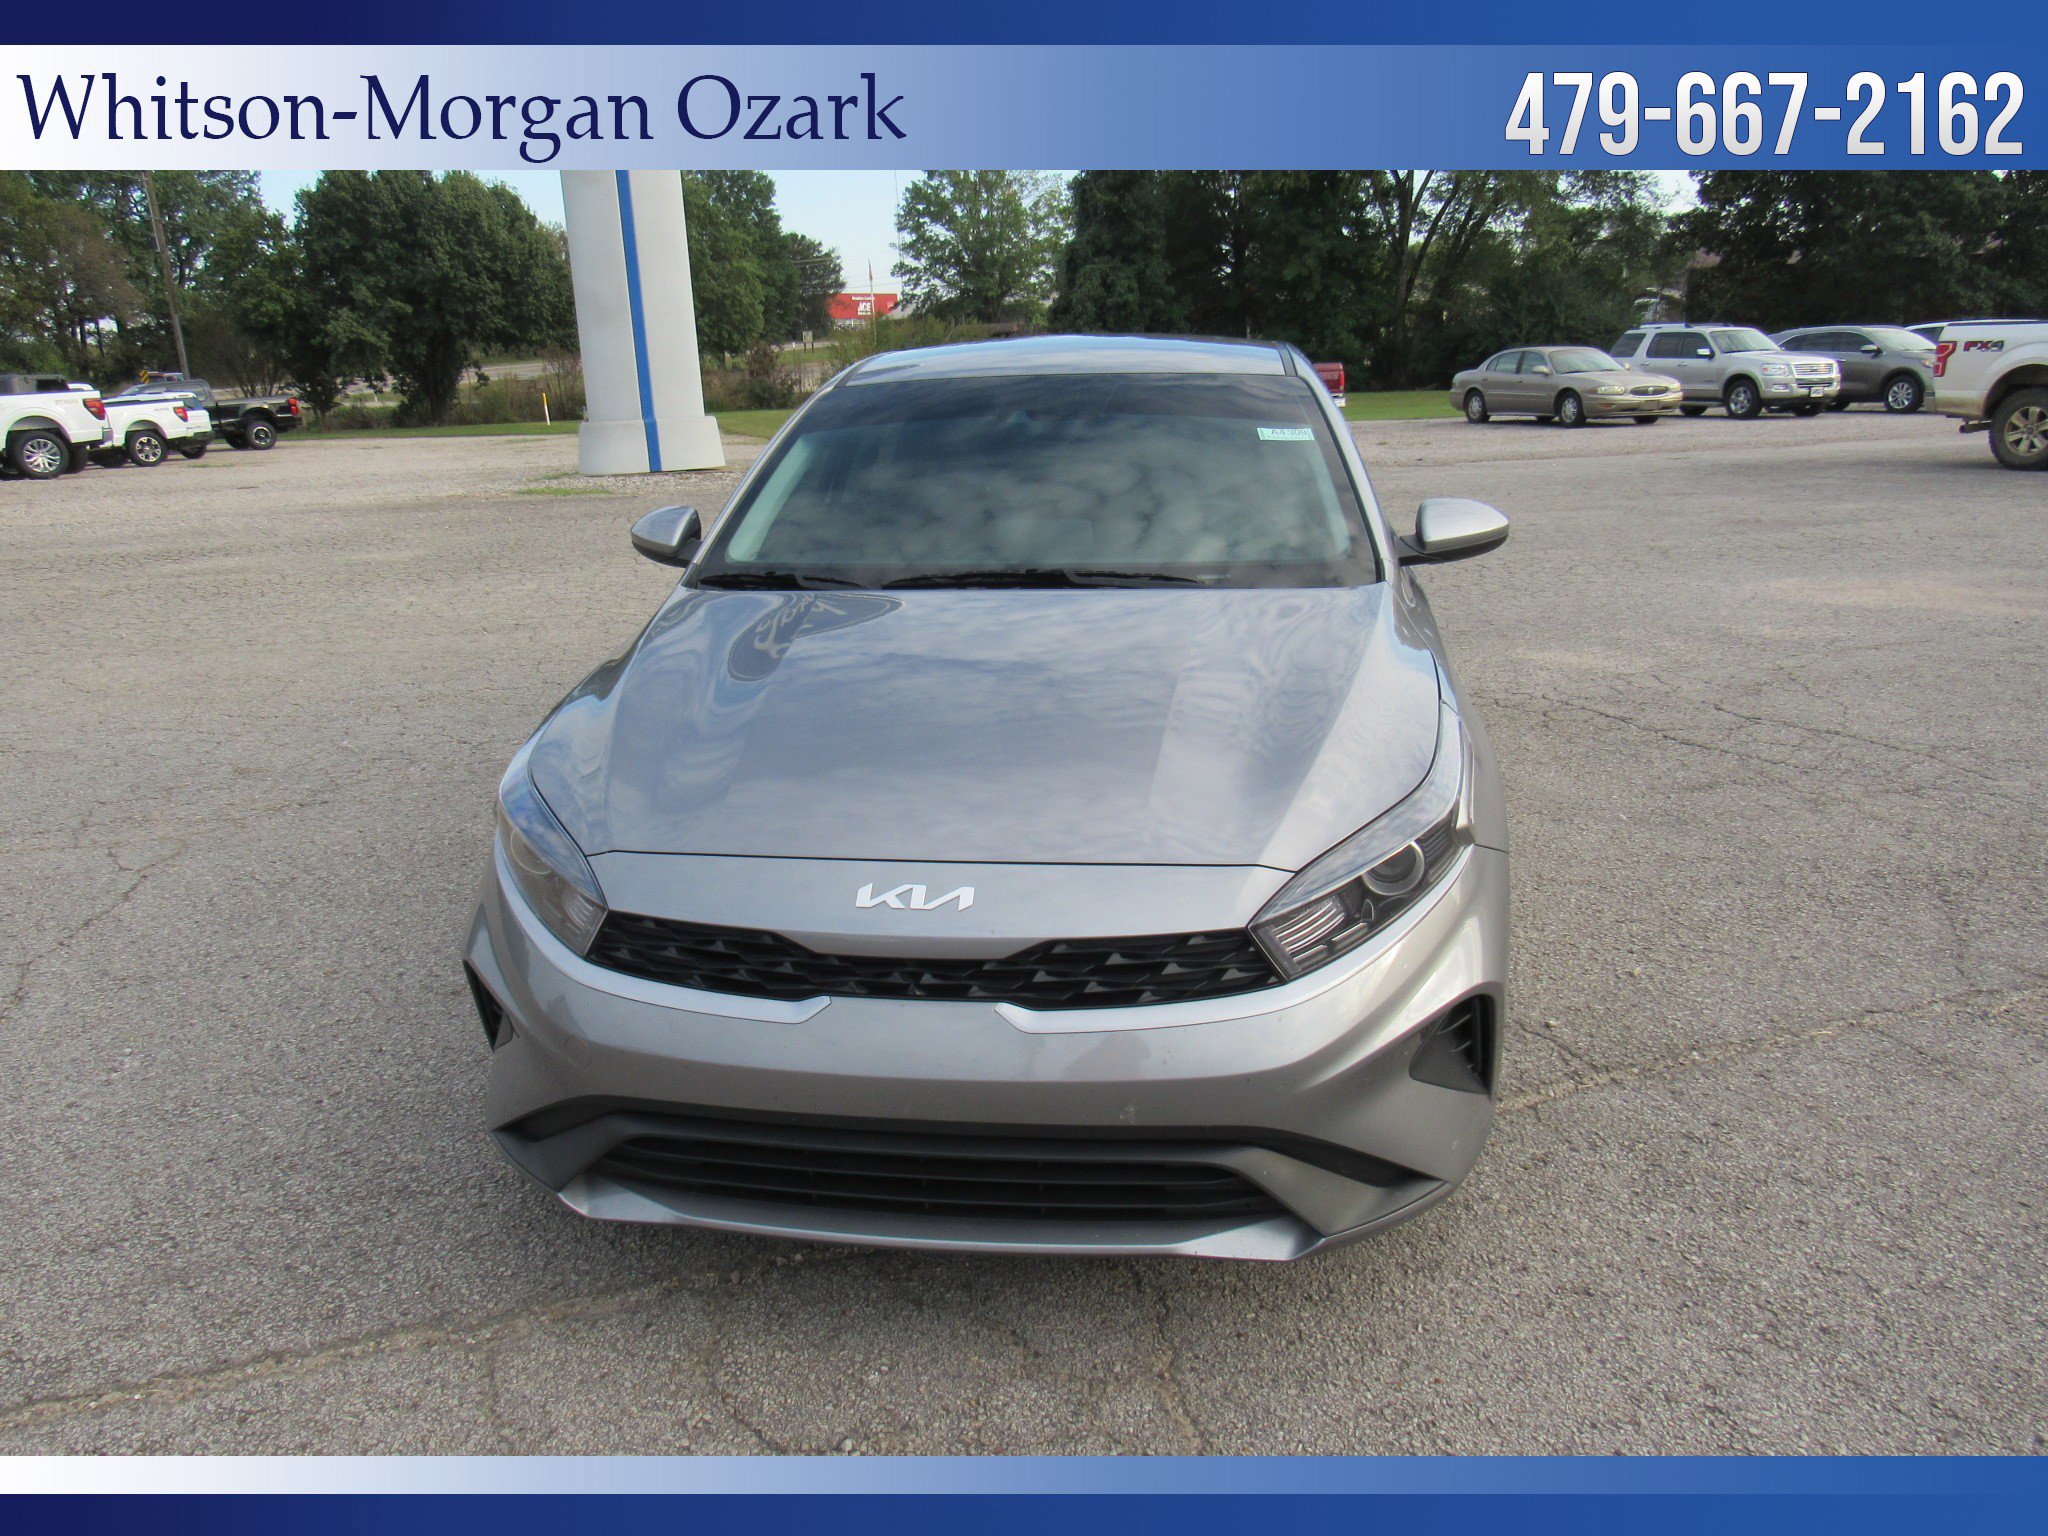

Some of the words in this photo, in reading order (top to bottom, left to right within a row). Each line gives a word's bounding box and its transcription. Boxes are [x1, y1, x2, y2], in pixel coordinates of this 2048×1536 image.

[858, 301, 871, 312] ACE
[1963, 340, 2005, 352] FX4
[855, 882, 975, 911] KIA
